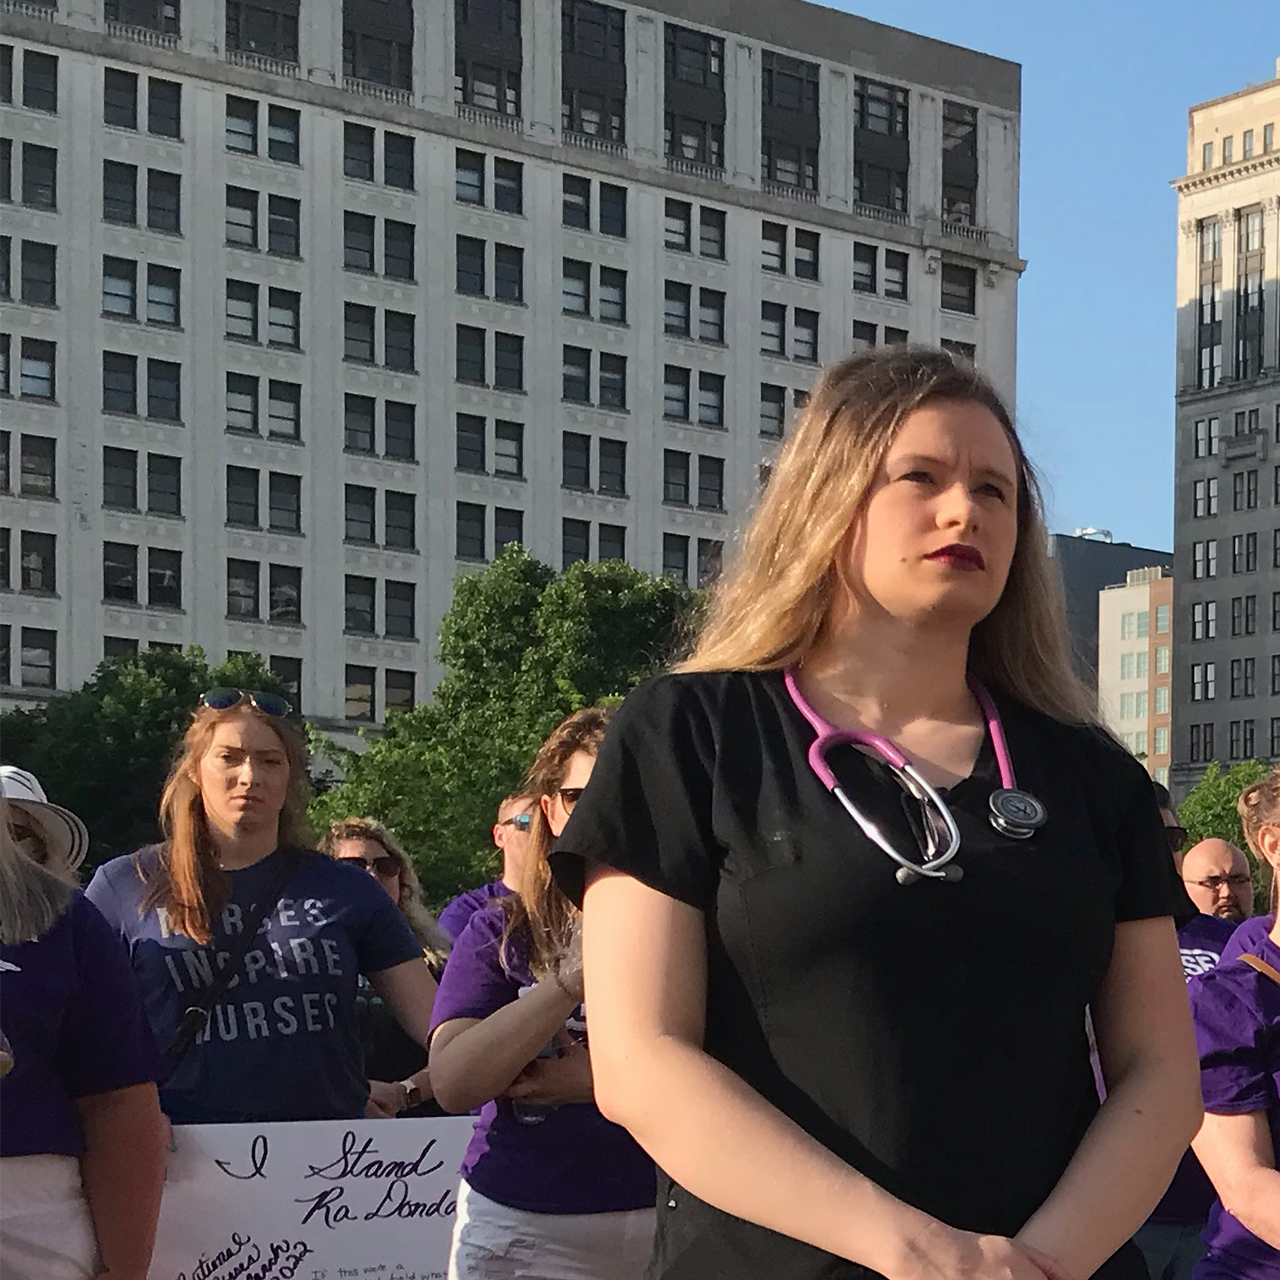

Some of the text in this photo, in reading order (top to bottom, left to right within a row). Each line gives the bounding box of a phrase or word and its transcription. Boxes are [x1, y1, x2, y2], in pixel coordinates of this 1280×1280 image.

[156, 898, 329, 939] NRES
[165, 937, 344, 992] INSPIRE
[215, 1131, 444, 1180] I Stand
[364, 1180, 457, 1221] Donda
[337, 1267, 359, 1279] this
[362, 1263, 387, 1275] were
[396, 1263, 405, 1271] a
[420, 1270, 448, 1280] what
